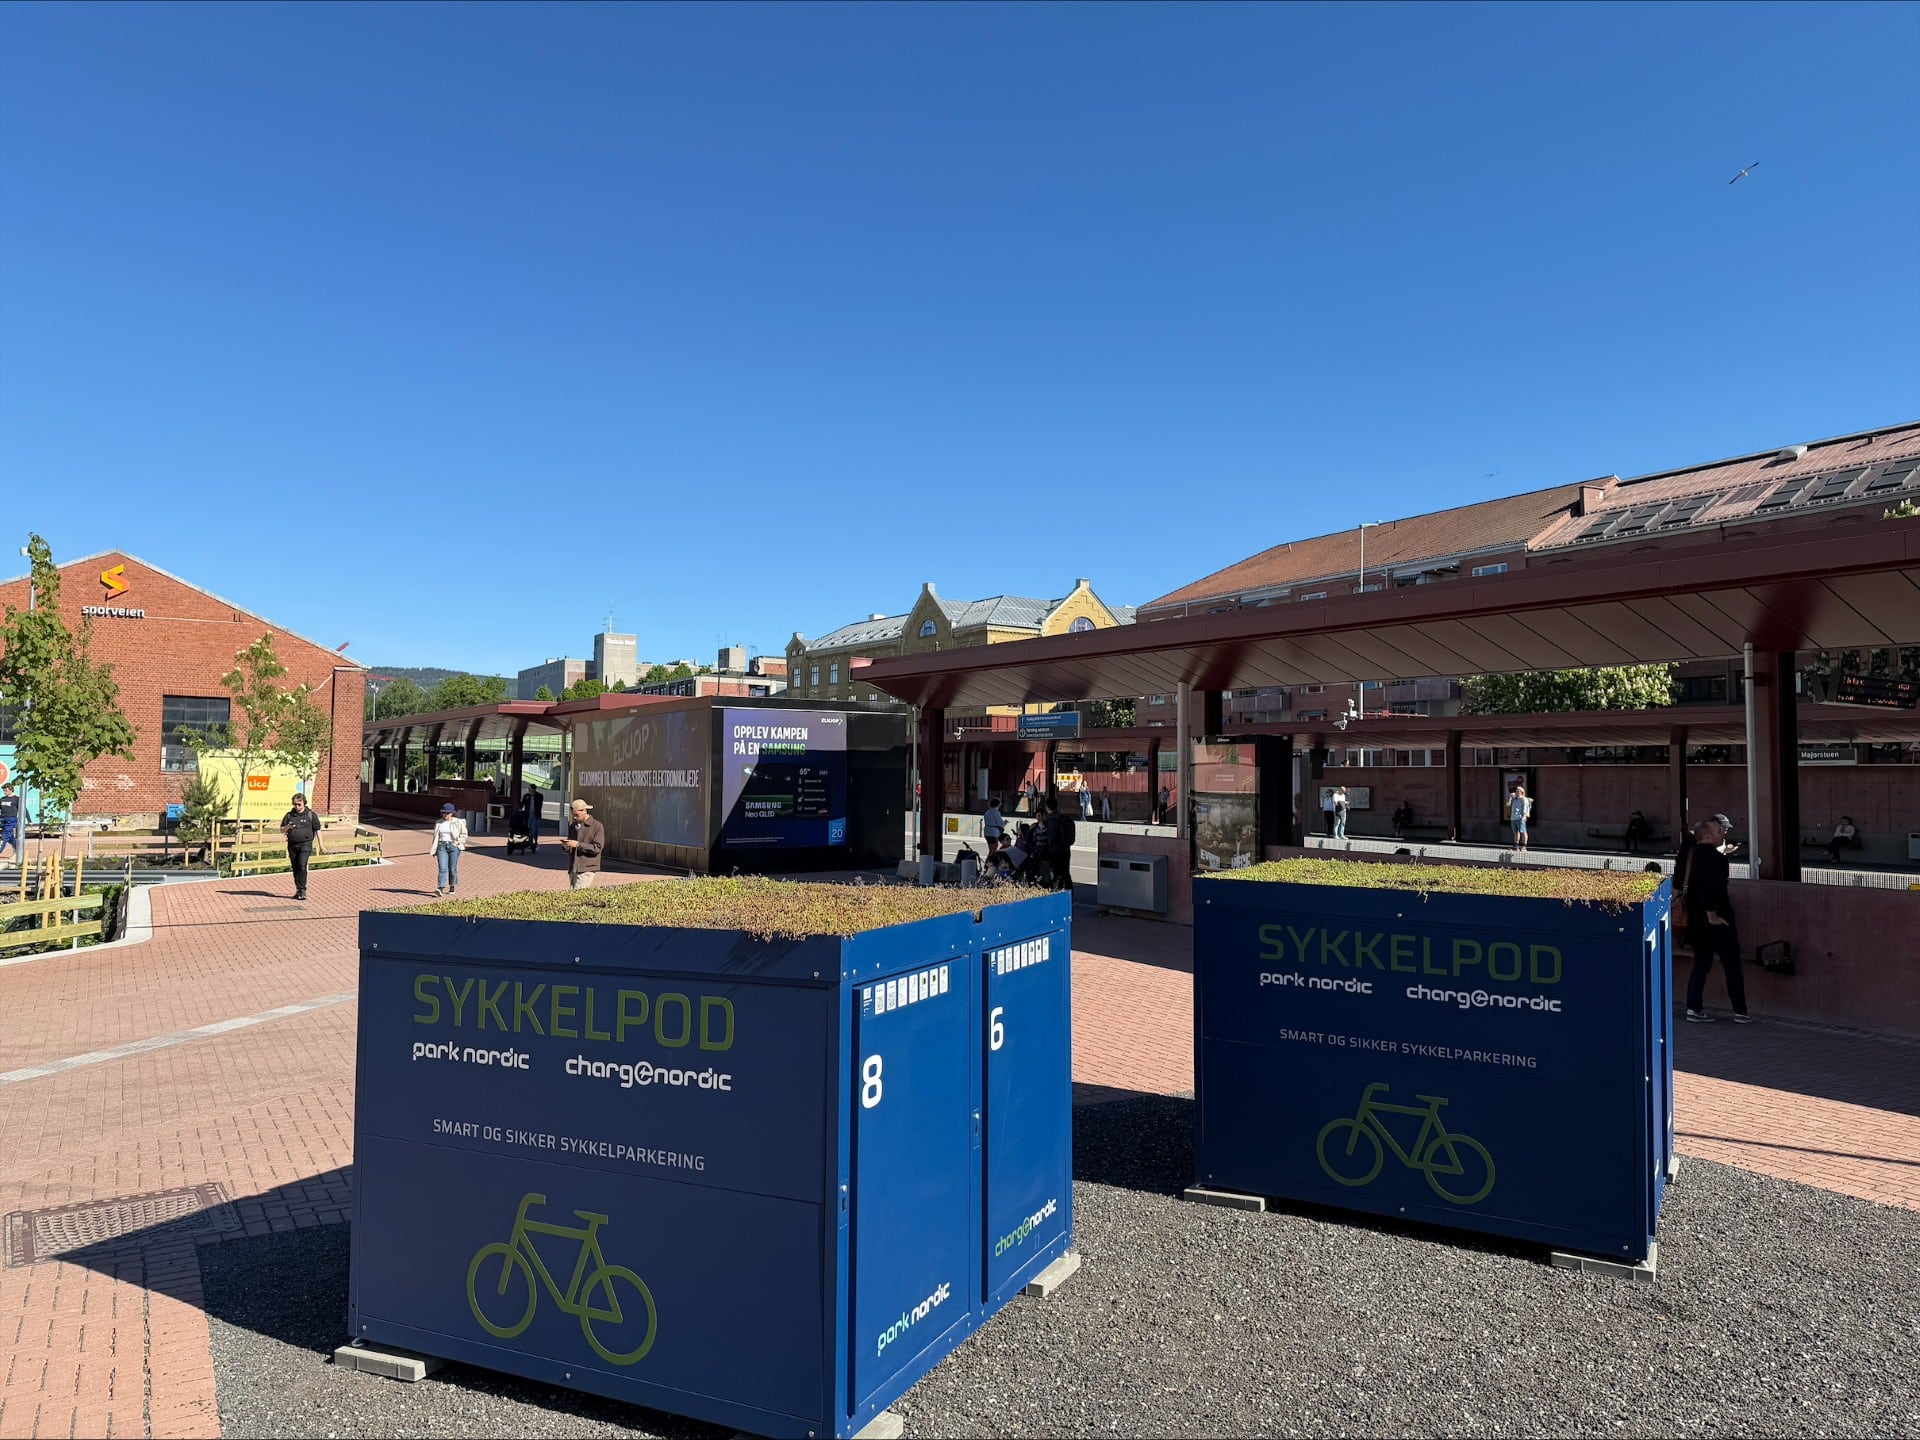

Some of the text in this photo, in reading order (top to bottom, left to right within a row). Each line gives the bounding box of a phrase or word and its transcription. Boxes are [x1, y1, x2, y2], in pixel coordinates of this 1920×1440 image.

[733, 725, 808, 740] OPPLEV KAMPEN
[733, 739, 806, 756] PÅ EN SAMSUNG
[1801, 751, 1840, 759] Majorstuen
[745, 801, 782, 809] SAMSUNG
[831, 828, 843, 838] 20
[1258, 923, 1563, 985] SYKKELPOD
[1259, 971, 1373, 995] park nordic
[413, 974, 735, 1051] SYKKELPOD
[990, 1006, 1004, 1051] 6
[412, 1041, 530, 1070] park nordic
[1279, 1028, 1537, 1069] SMART OG SIKKER SYKKELPARKERING
[861, 1054, 883, 1109] 8
[433, 1118, 705, 1172] SMART OG SIKKER SYKKELPARKERING
[877, 1281, 951, 1357] park nordic
